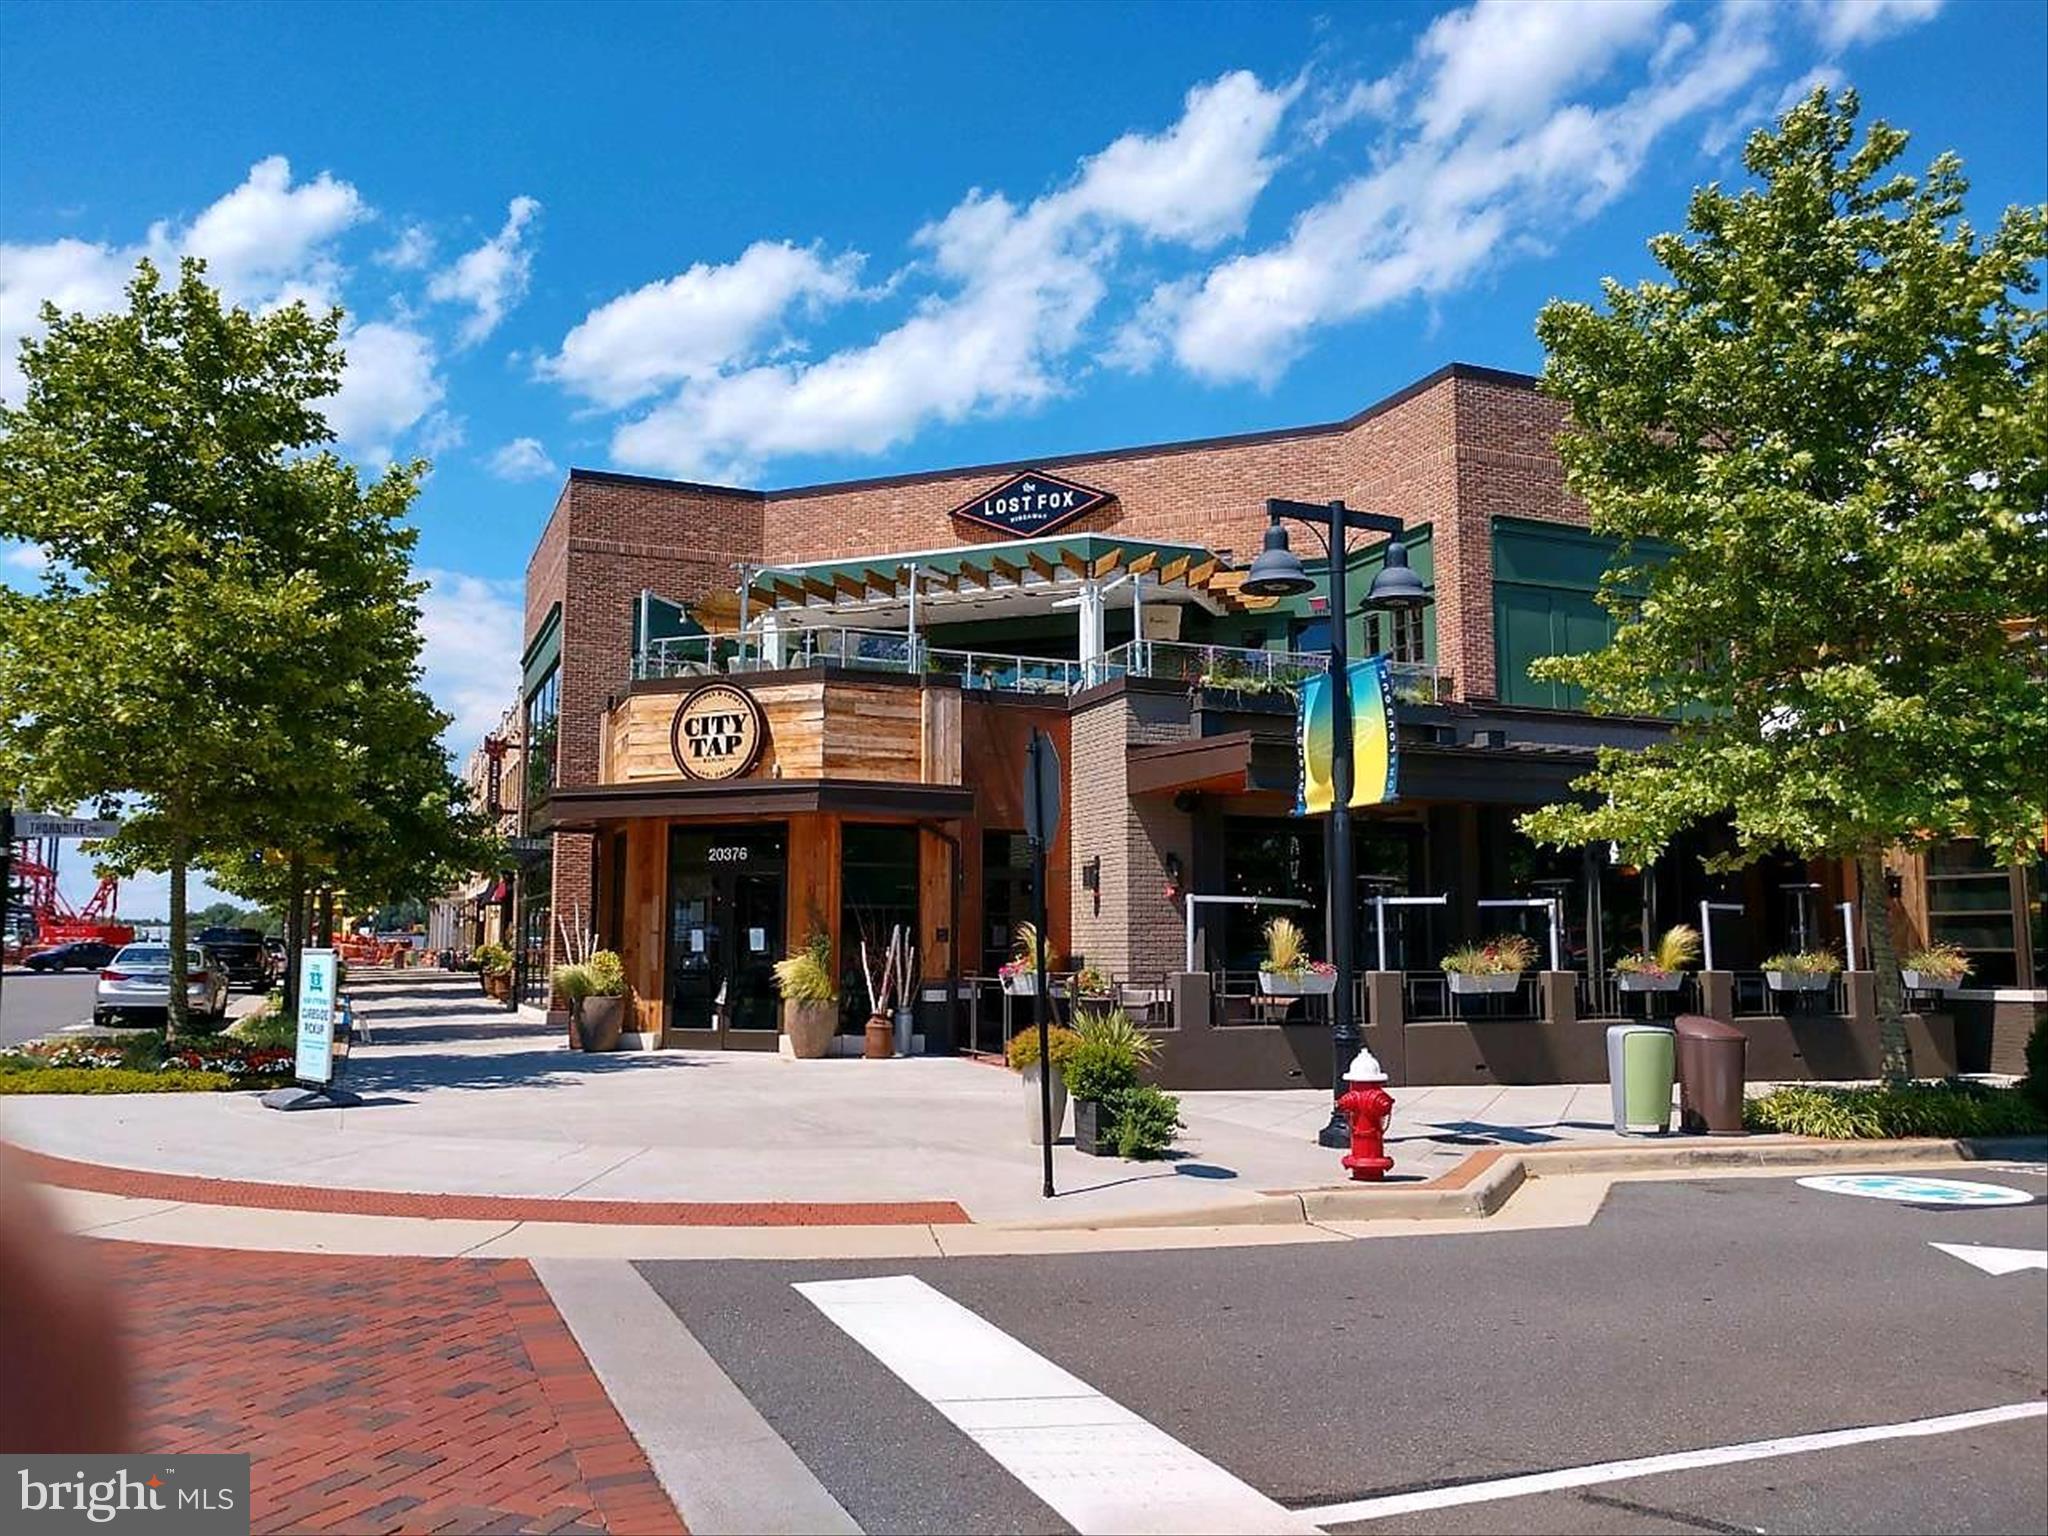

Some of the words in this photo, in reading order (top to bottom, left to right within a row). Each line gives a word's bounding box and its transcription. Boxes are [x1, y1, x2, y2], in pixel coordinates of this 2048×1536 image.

[984, 495, 1032, 516] LOST
[1037, 491, 1074, 509] FOX
[684, 713, 749, 737] CITY
[689, 735, 742, 757] TAP
[708, 847, 748, 862] 20376
